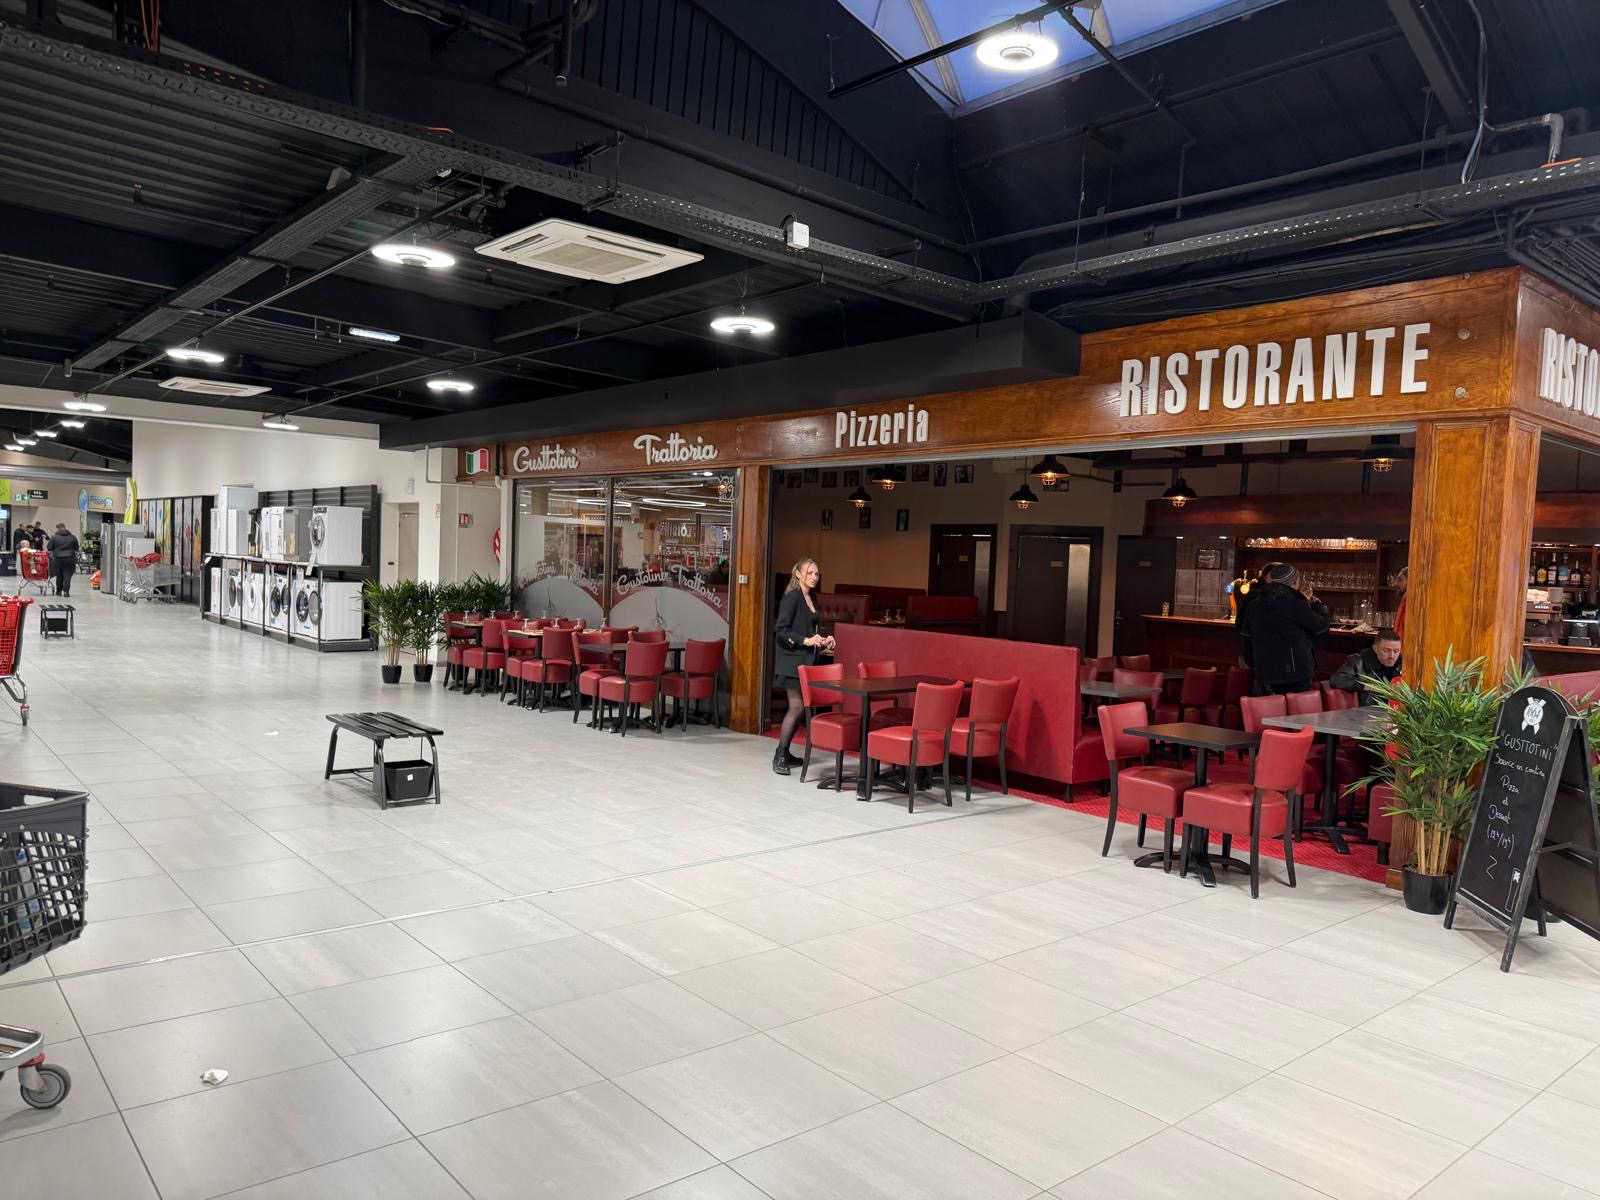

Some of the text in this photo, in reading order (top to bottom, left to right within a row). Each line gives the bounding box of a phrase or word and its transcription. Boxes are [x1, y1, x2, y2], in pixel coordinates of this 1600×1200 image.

[1120, 323, 1430, 417] RISTORANTE
[1540, 327, 1600, 418] RISTO
[835, 404, 929, 449] Pizzeria
[512, 432, 719, 473] Gusttotini Trattoria
[670, 564, 722, 608] Trattoria
[1500, 774, 1520, 794] Pizza
